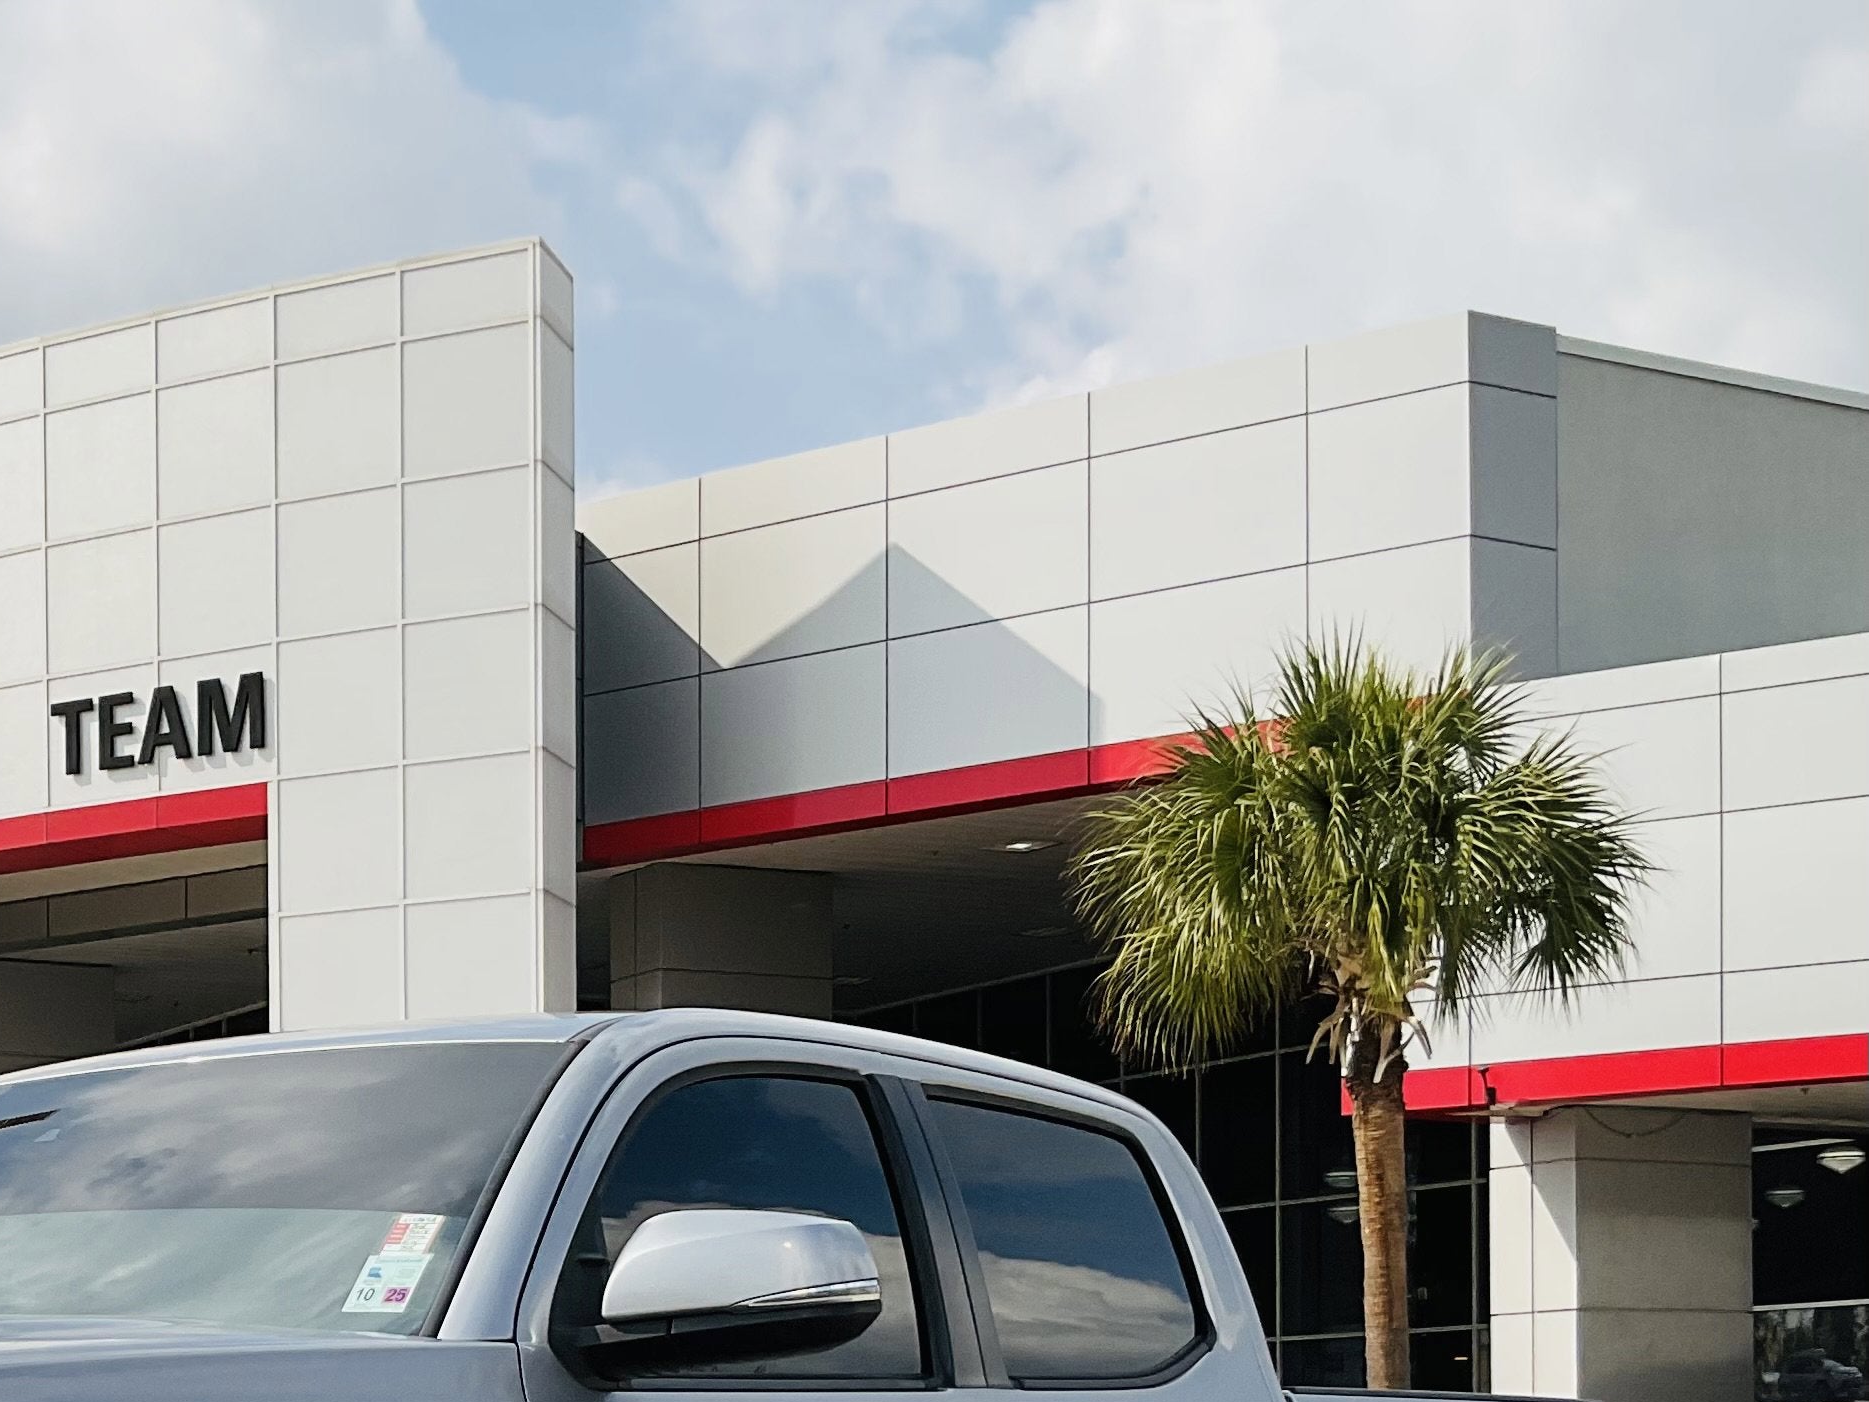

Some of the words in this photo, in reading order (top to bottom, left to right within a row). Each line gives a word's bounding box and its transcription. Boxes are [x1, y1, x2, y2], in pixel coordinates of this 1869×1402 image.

[50, 670, 265, 776] TEAM
[356, 1287, 376, 1301] 10
[384, 1288, 409, 1302] 25
